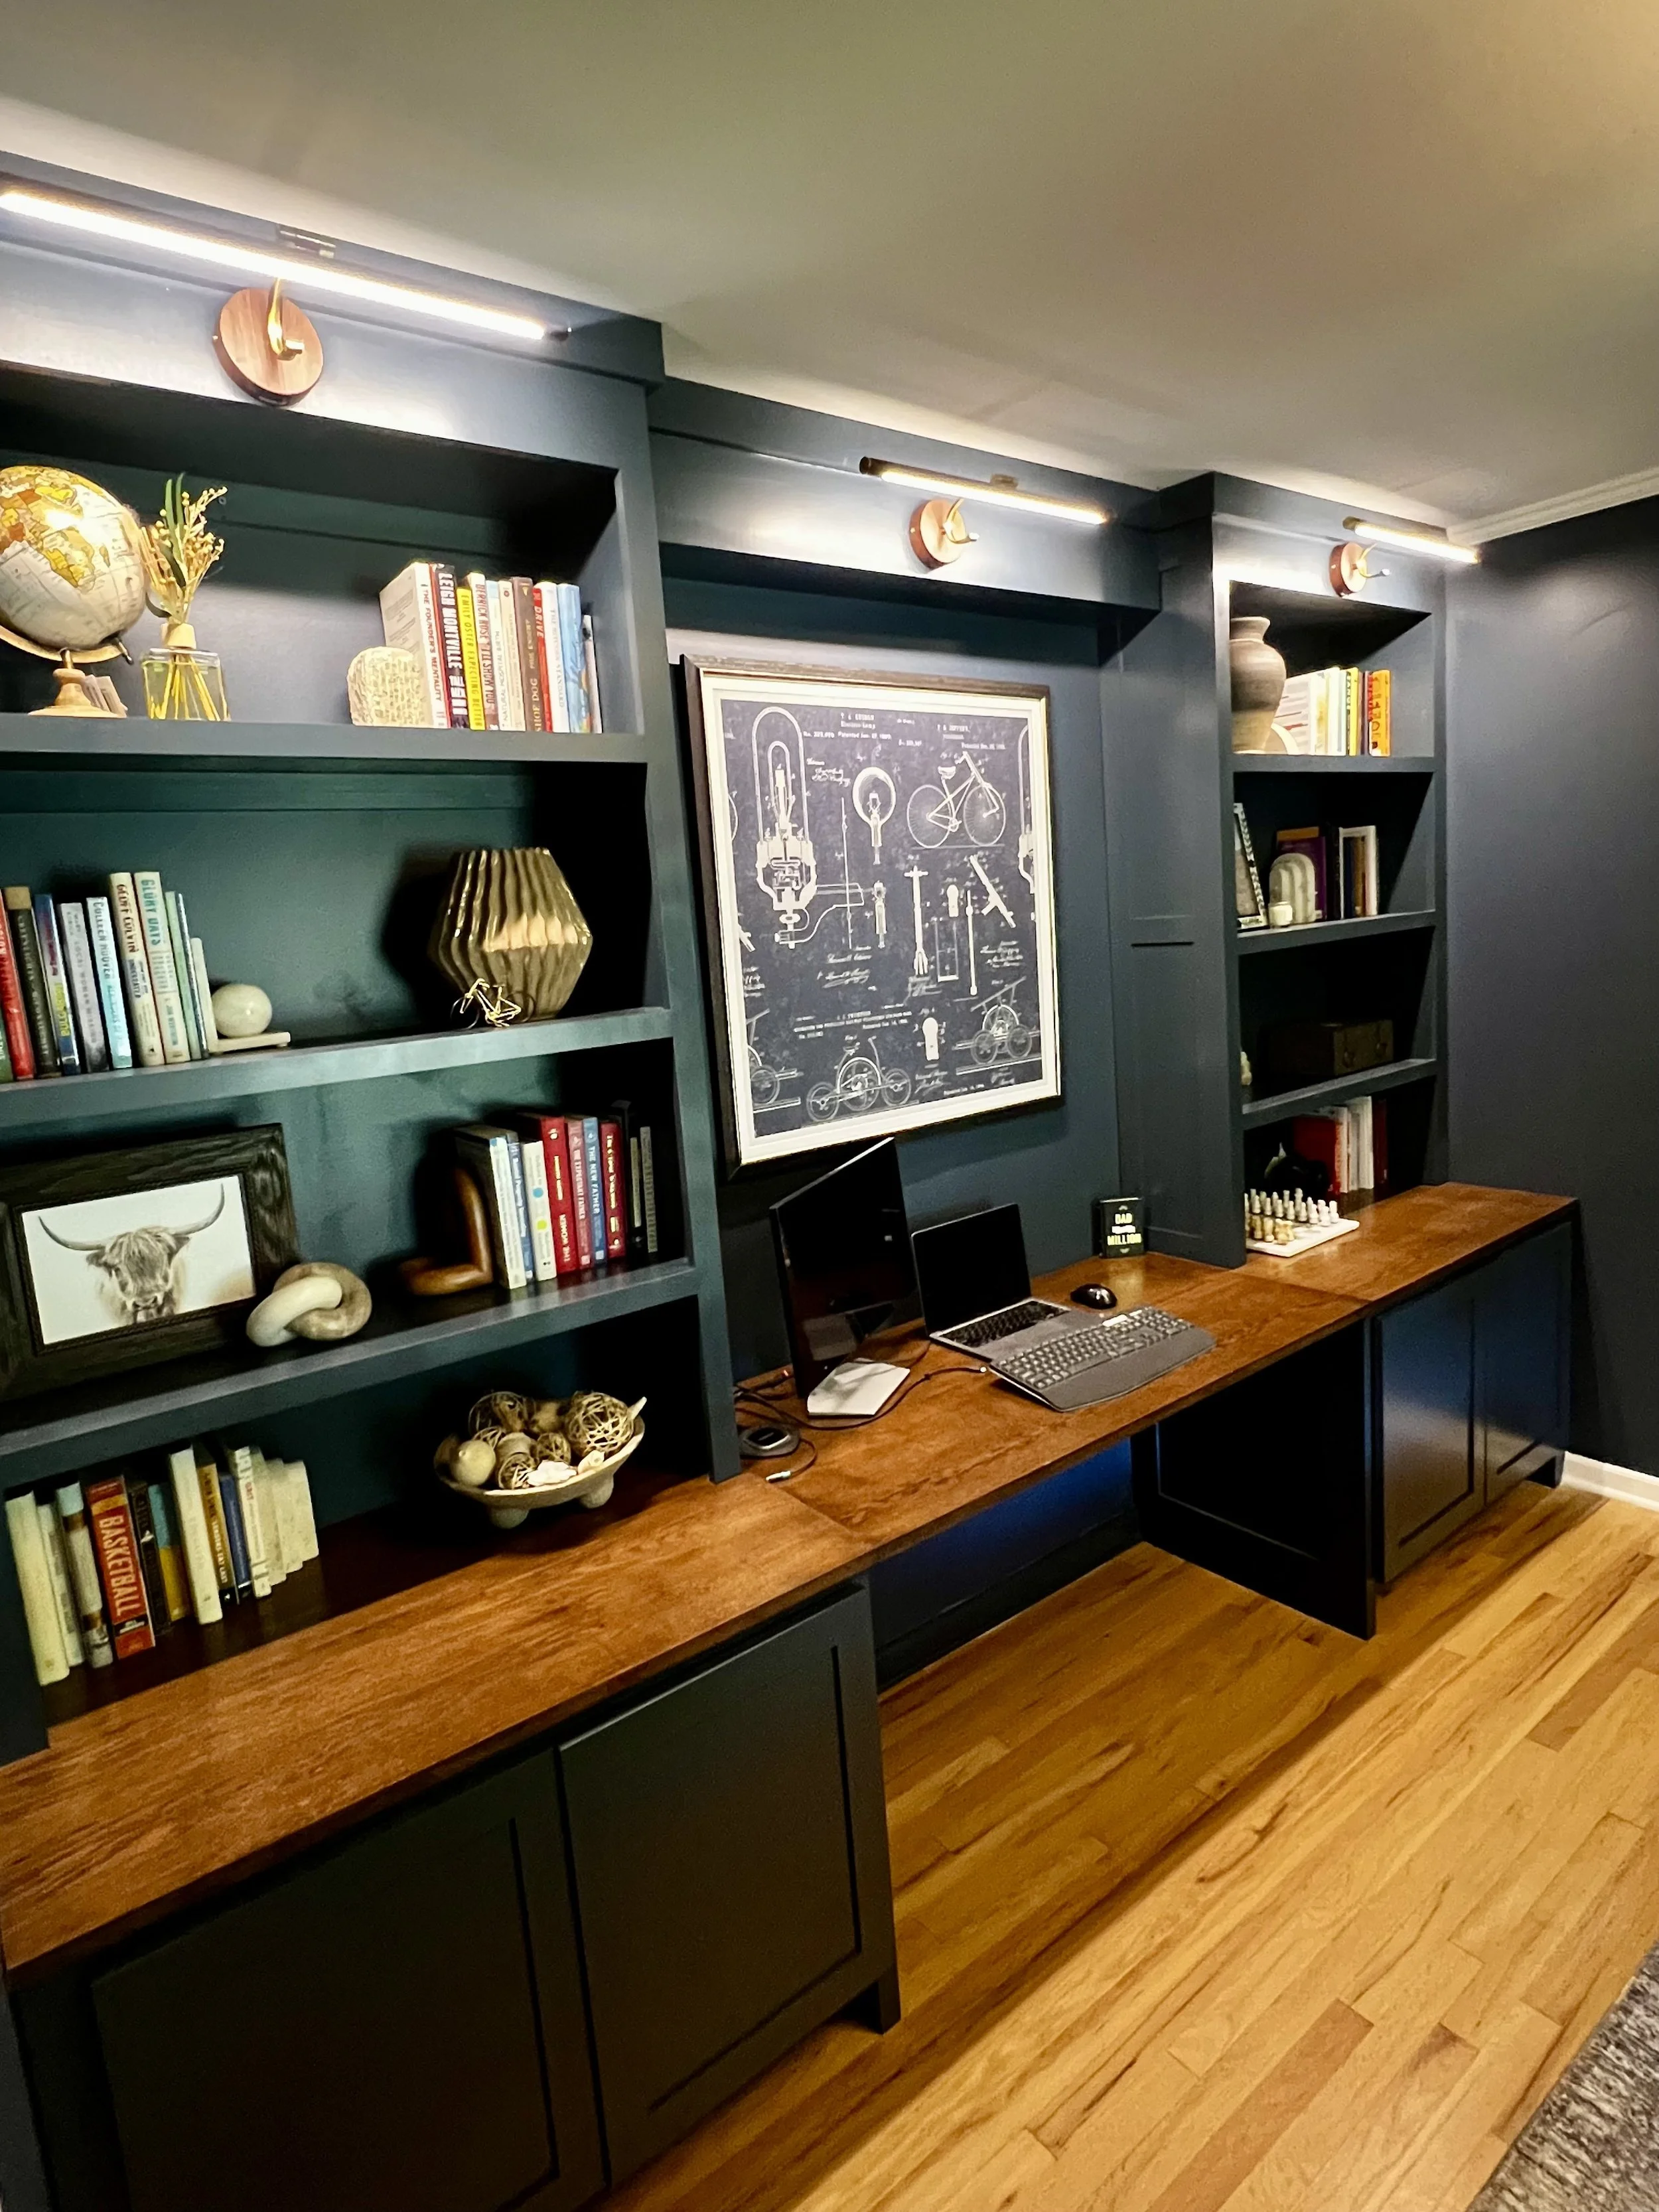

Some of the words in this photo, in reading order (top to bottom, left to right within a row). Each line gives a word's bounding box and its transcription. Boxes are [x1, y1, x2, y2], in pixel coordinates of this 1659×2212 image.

[439, 573, 456, 605] LEIGH
[475, 584, 487, 617] DERRICK
[461, 595, 471, 619] EMILY
[534, 605, 544, 638] DRIVE
[442, 608, 463, 670] MONTVILLE
[465, 622, 474, 647] OSTER
[478, 619, 489, 639] ROSE
[425, 608, 435, 654] FOUNDER'S
[431, 657, 441, 701] MENTALITY
[467, 650, 479, 695] EXPECTING
[483, 663, 495, 689] SHOW
[485, 688, 495, 704] YOU
[530, 678, 540, 701] DOG
[472, 698, 482, 727] BETTER
[141, 879, 157, 913] GLORY
[93, 902, 107, 941] COLLEEN
[147, 917, 161, 946] DAYS
[589, 1163, 598, 1181] NEW
[591, 1183, 601, 1215] FATHER
[1115, 1213, 1133, 1224] DAD
[1107, 1233, 1142, 1246] MILLION
[99, 1514, 141, 1617] BASKETBALL
